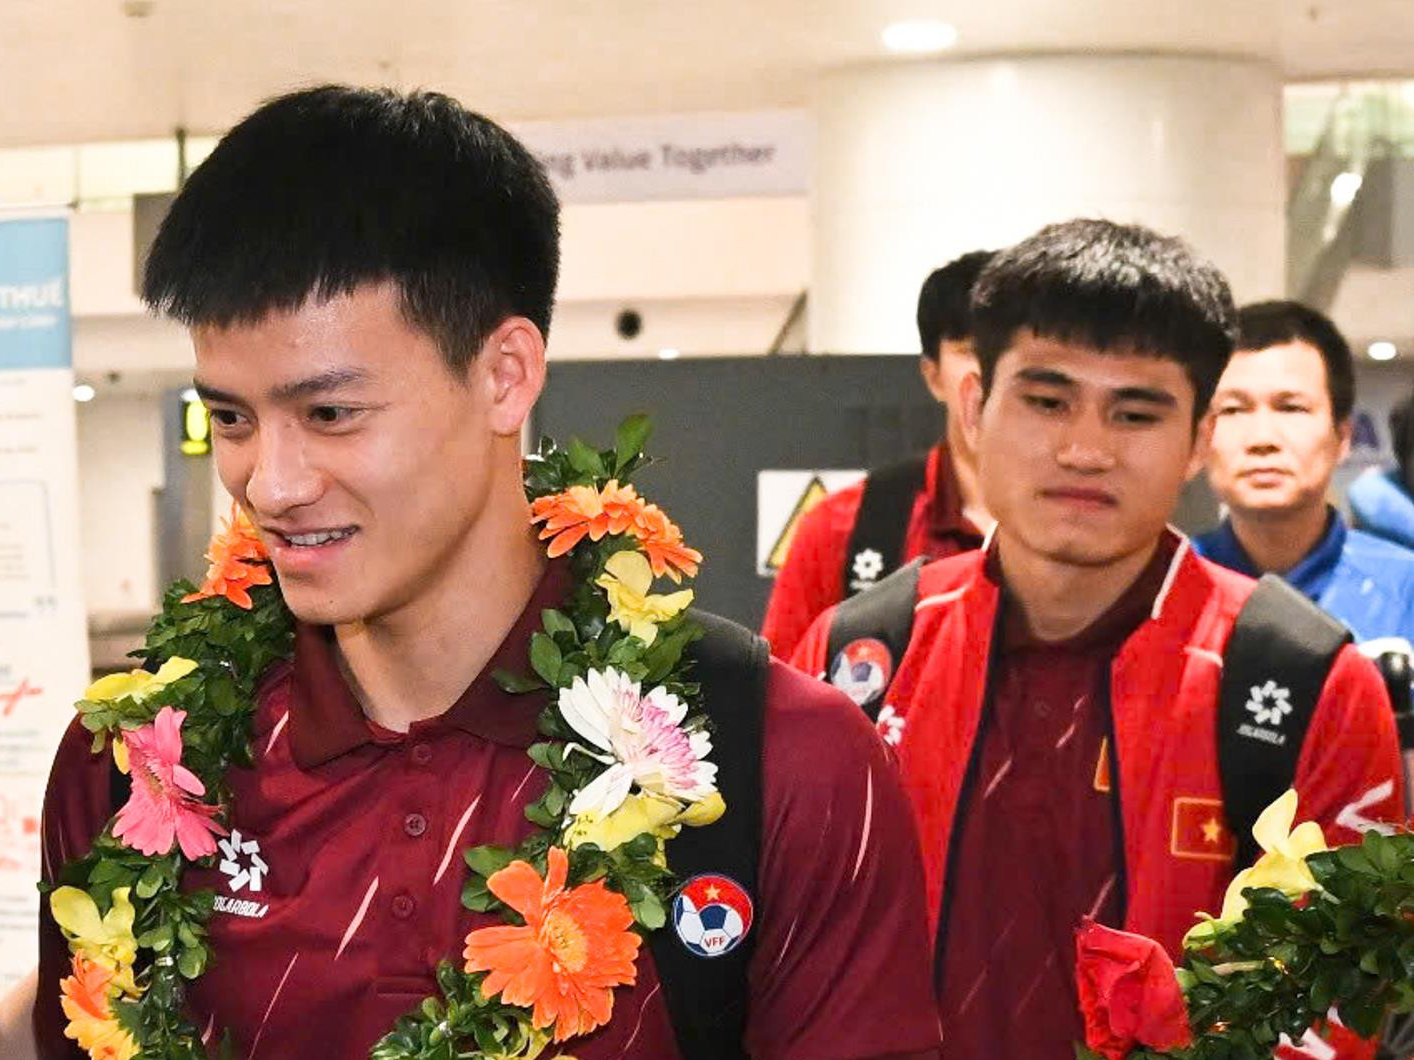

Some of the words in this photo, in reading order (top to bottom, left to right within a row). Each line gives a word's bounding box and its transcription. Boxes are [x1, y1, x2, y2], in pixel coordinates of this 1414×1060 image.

[582, 148, 652, 173] Value
[661, 142, 777, 175] Together
[704, 935, 727, 949] VFF
